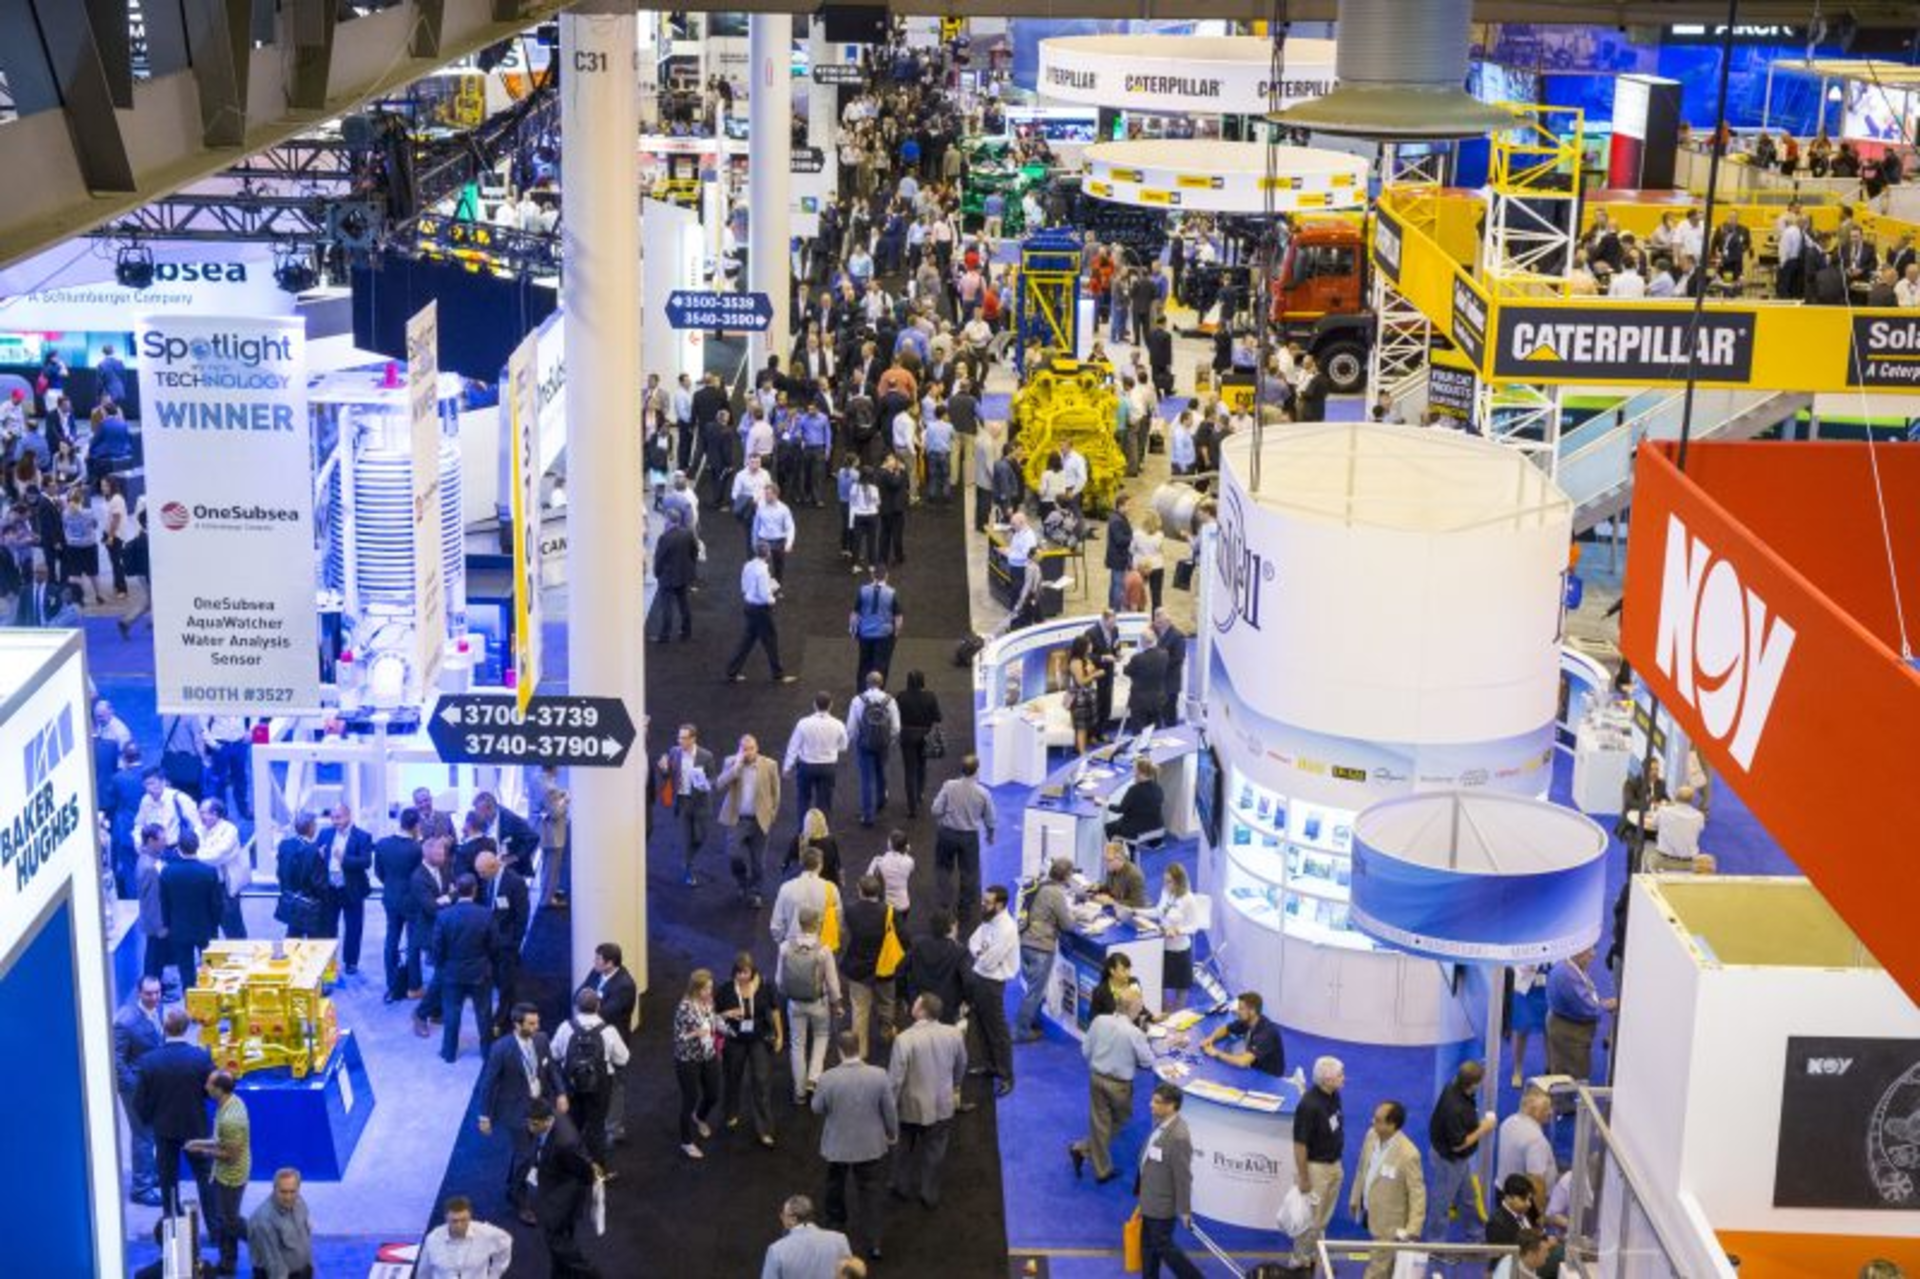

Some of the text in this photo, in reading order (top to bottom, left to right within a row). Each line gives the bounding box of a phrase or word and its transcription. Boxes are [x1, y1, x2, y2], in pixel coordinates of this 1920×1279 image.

[575, 52, 608, 72] C31
[1125, 74, 1220, 97] CATERPILLAR
[143, 330, 293, 368] Spotlight
[1511, 323, 1736, 366] CATERPILLAR
[154, 371, 290, 389] TECHNOLOGY
[155, 400, 294, 431] WINNER
[193, 505, 299, 521] OneSubsea
[193, 597, 275, 611] OneSubsea
[186, 616, 283, 630] AquaWatcher
[181, 633, 291, 649] Water Analysis
[1655, 512, 1796, 776] NOV
[210, 652, 262, 666] Sensor
[182, 686, 294, 702] BOOTH #3527
[464, 704, 599, 727] 3700-3739
[465, 734, 599, 757] 3740-3790
[1, 779, 55, 868] BAKER
[16, 791, 80, 893] HUGHES
